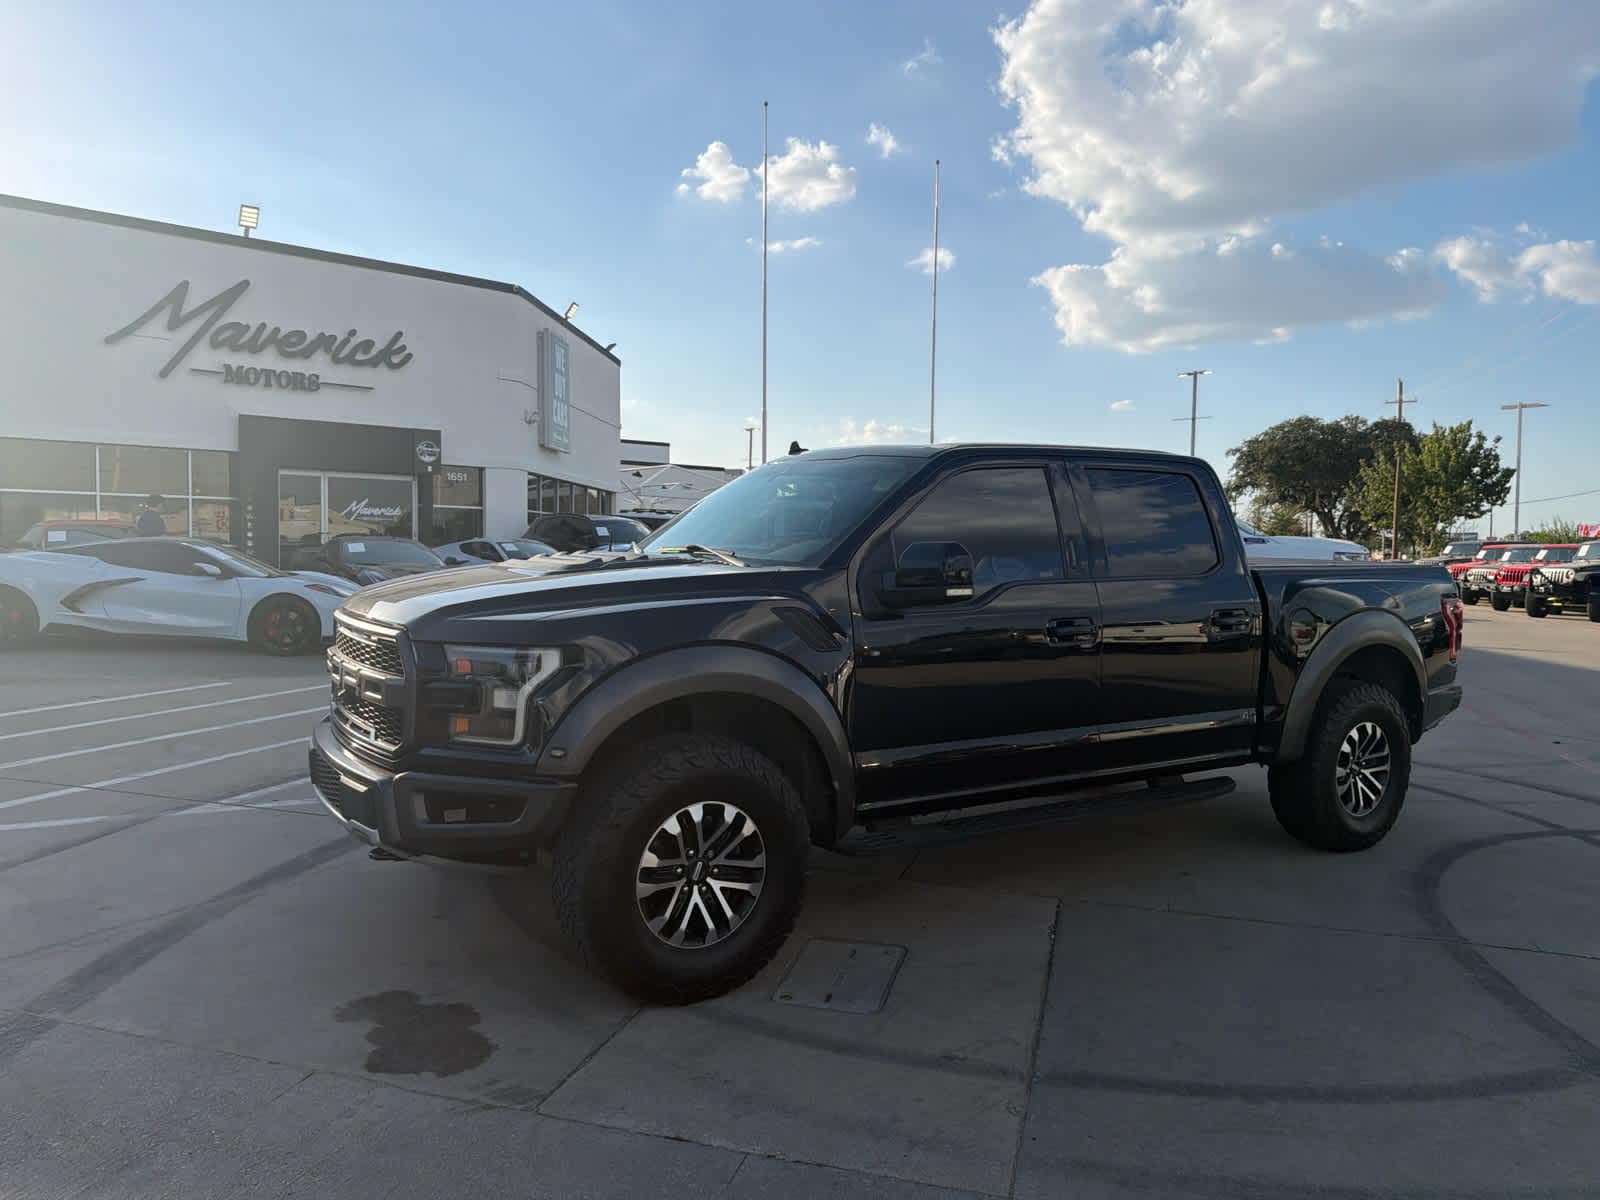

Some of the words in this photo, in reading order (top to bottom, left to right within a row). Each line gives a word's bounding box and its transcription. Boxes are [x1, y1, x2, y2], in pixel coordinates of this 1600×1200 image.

[104, 279, 414, 379] Maverick
[223, 364, 321, 392] MOTORS
[447, 471, 468, 481] 1651
